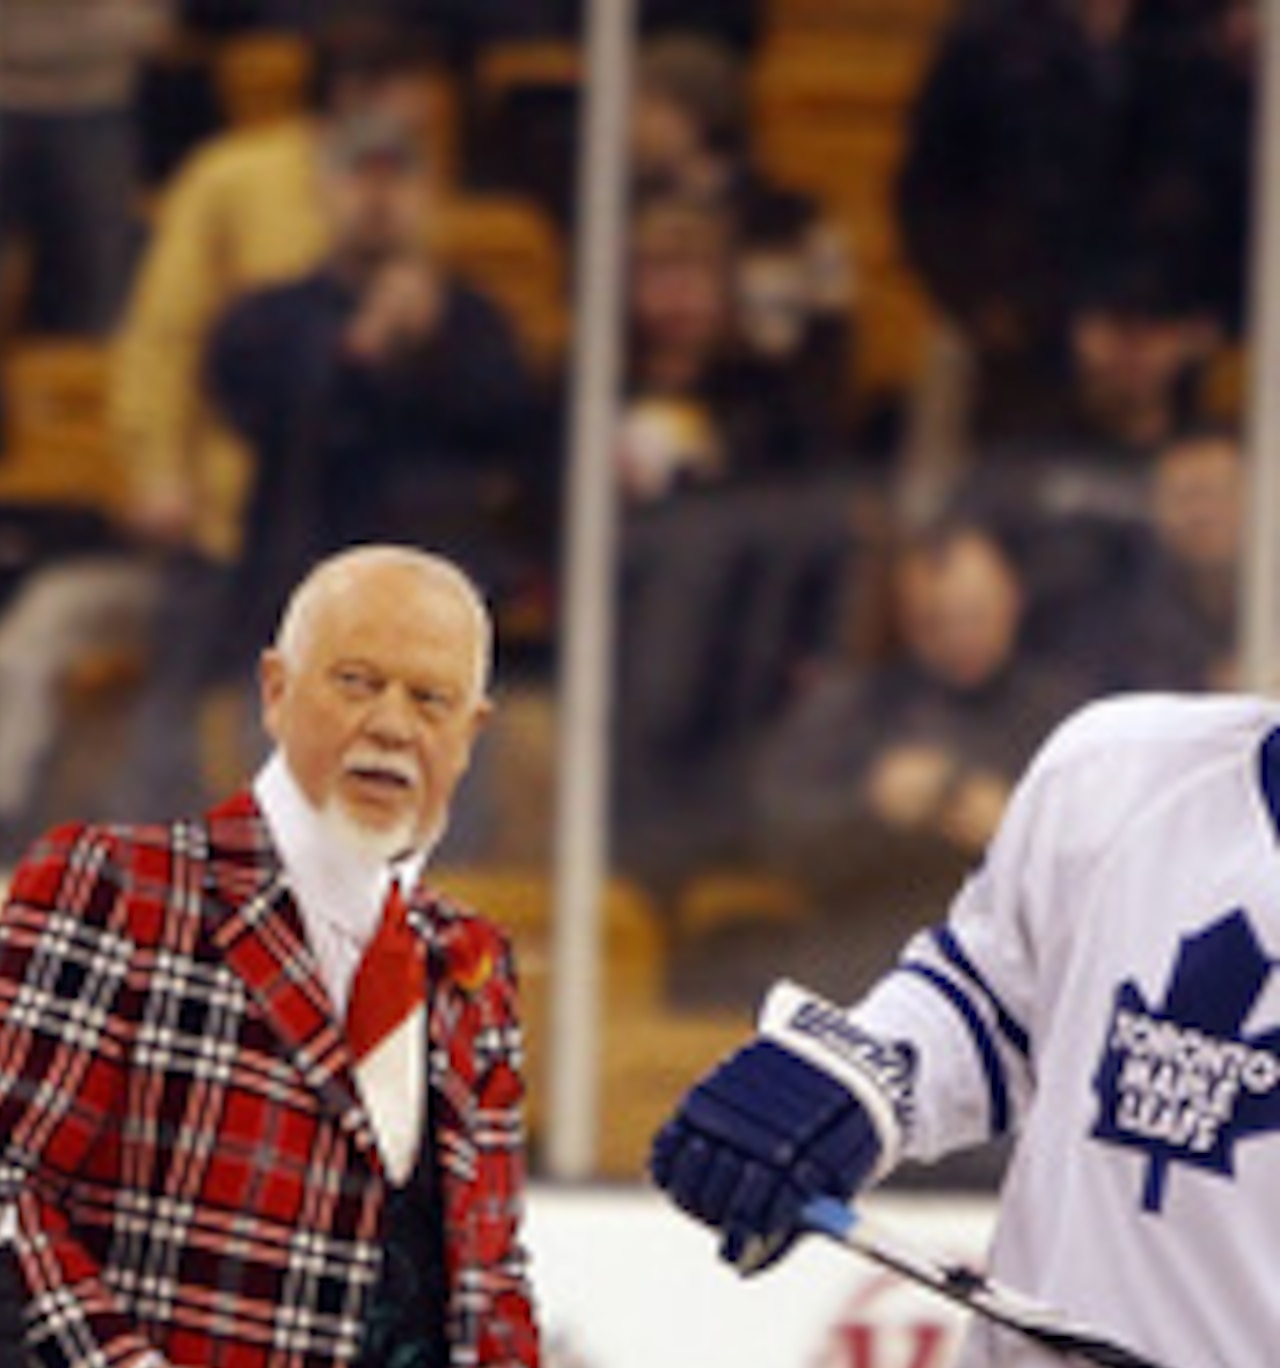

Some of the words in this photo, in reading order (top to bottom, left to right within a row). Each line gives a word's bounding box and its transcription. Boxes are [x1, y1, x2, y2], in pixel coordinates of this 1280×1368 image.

[1109, 1008, 1280, 1094] TORONTO
[1115, 1090, 1220, 1151] LEAFS
[1117, 1056, 1238, 1124] MAPLE
